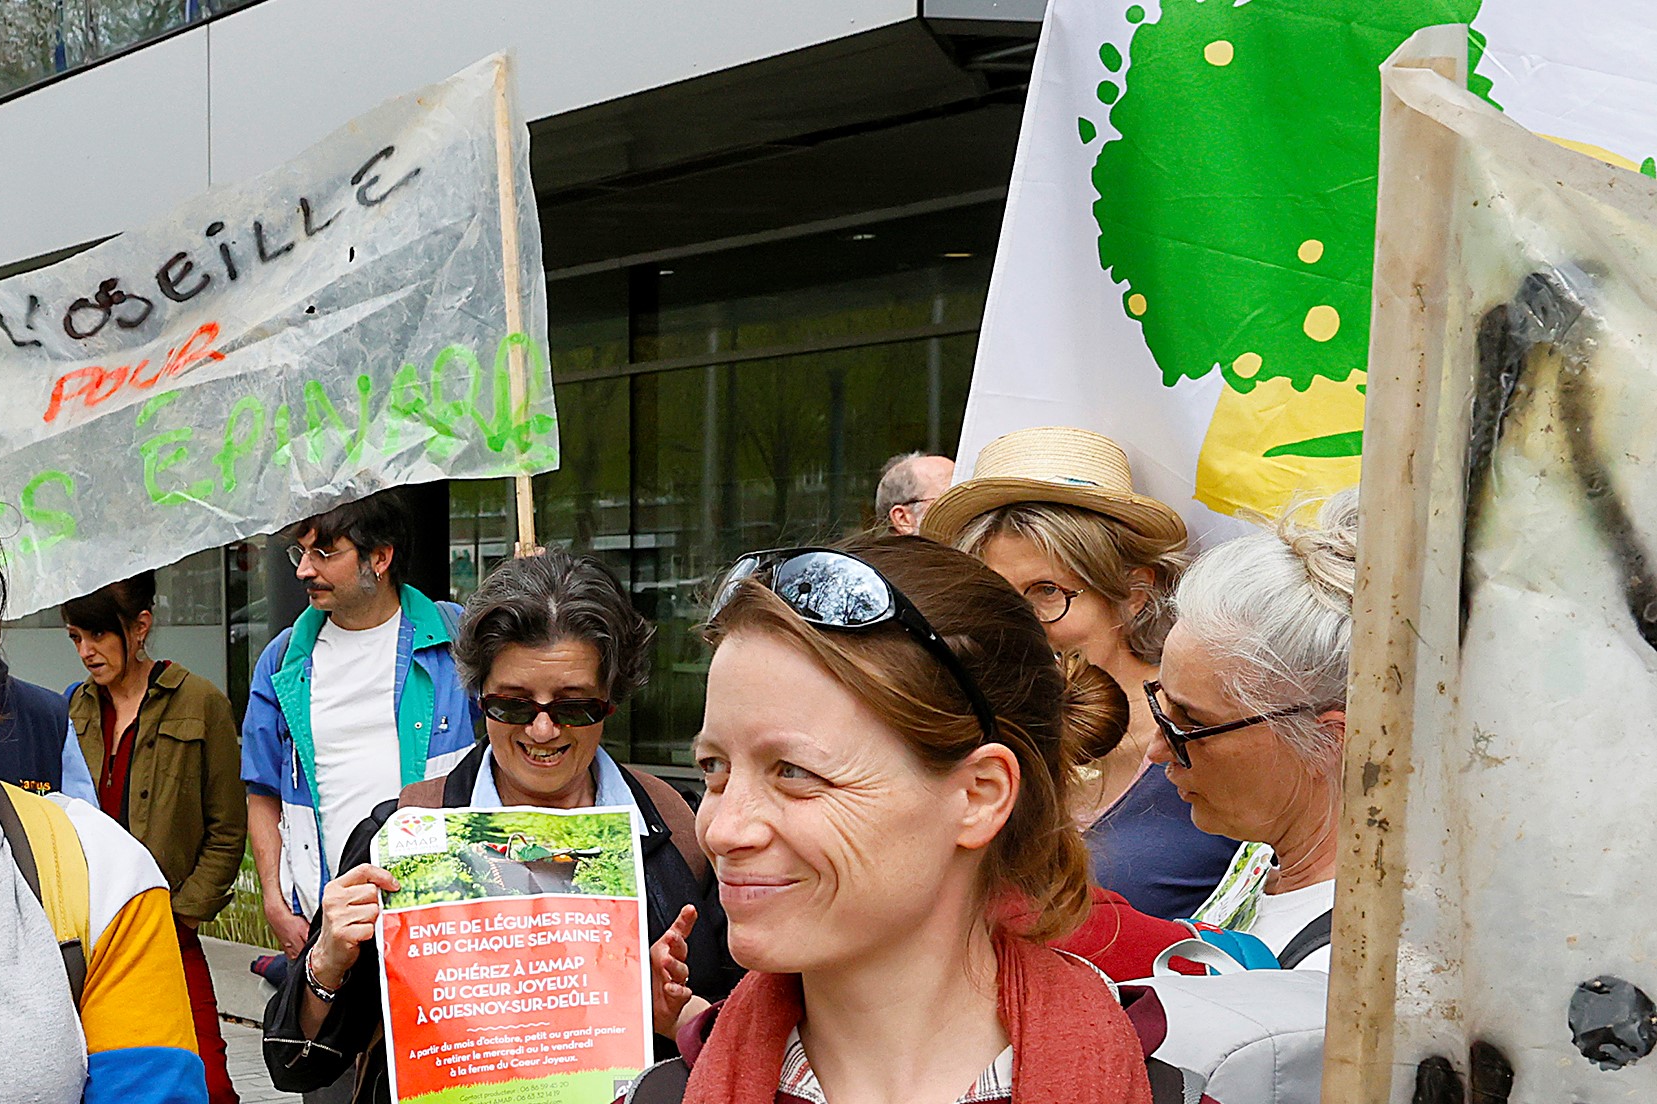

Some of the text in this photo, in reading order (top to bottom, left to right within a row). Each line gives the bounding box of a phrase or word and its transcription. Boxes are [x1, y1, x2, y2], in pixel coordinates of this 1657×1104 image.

[43, 322, 225, 422] POUR
[395, 837, 438, 849] AMAP
[409, 912, 610, 939] ENVIE DE LÉGUMES FRAIS
[407, 944, 420, 958] &
[422, 940, 451, 956] BIO
[454, 934, 524, 953] CHAQUE
[528, 930, 601, 947] SEMAINE
[434, 964, 510, 983] ADHÉREZ
[513, 959, 526, 976] À
[433, 986, 456, 1002] DU
[459, 982, 511, 999] CŒUR
[514, 975, 579, 995] JOYEUX
[416, 1006, 428, 1025] À
[429, 990, 601, 1023] QUESNOY-SUR-DEÛLE
[417, 1045, 440, 1060] partir
[441, 1042, 453, 1053] du
[453, 1040, 475, 1051] mois
[524, 1032, 547, 1044] petit
[549, 1032, 562, 1040] ou
[563, 1026, 593, 1041] grand
[594, 1025, 626, 1037] panier
[435, 1038, 594, 1067] à retirer le mercredi ou le vendredi
[449, 1054, 578, 1078] à la ferme du Coeur Joyeux.
